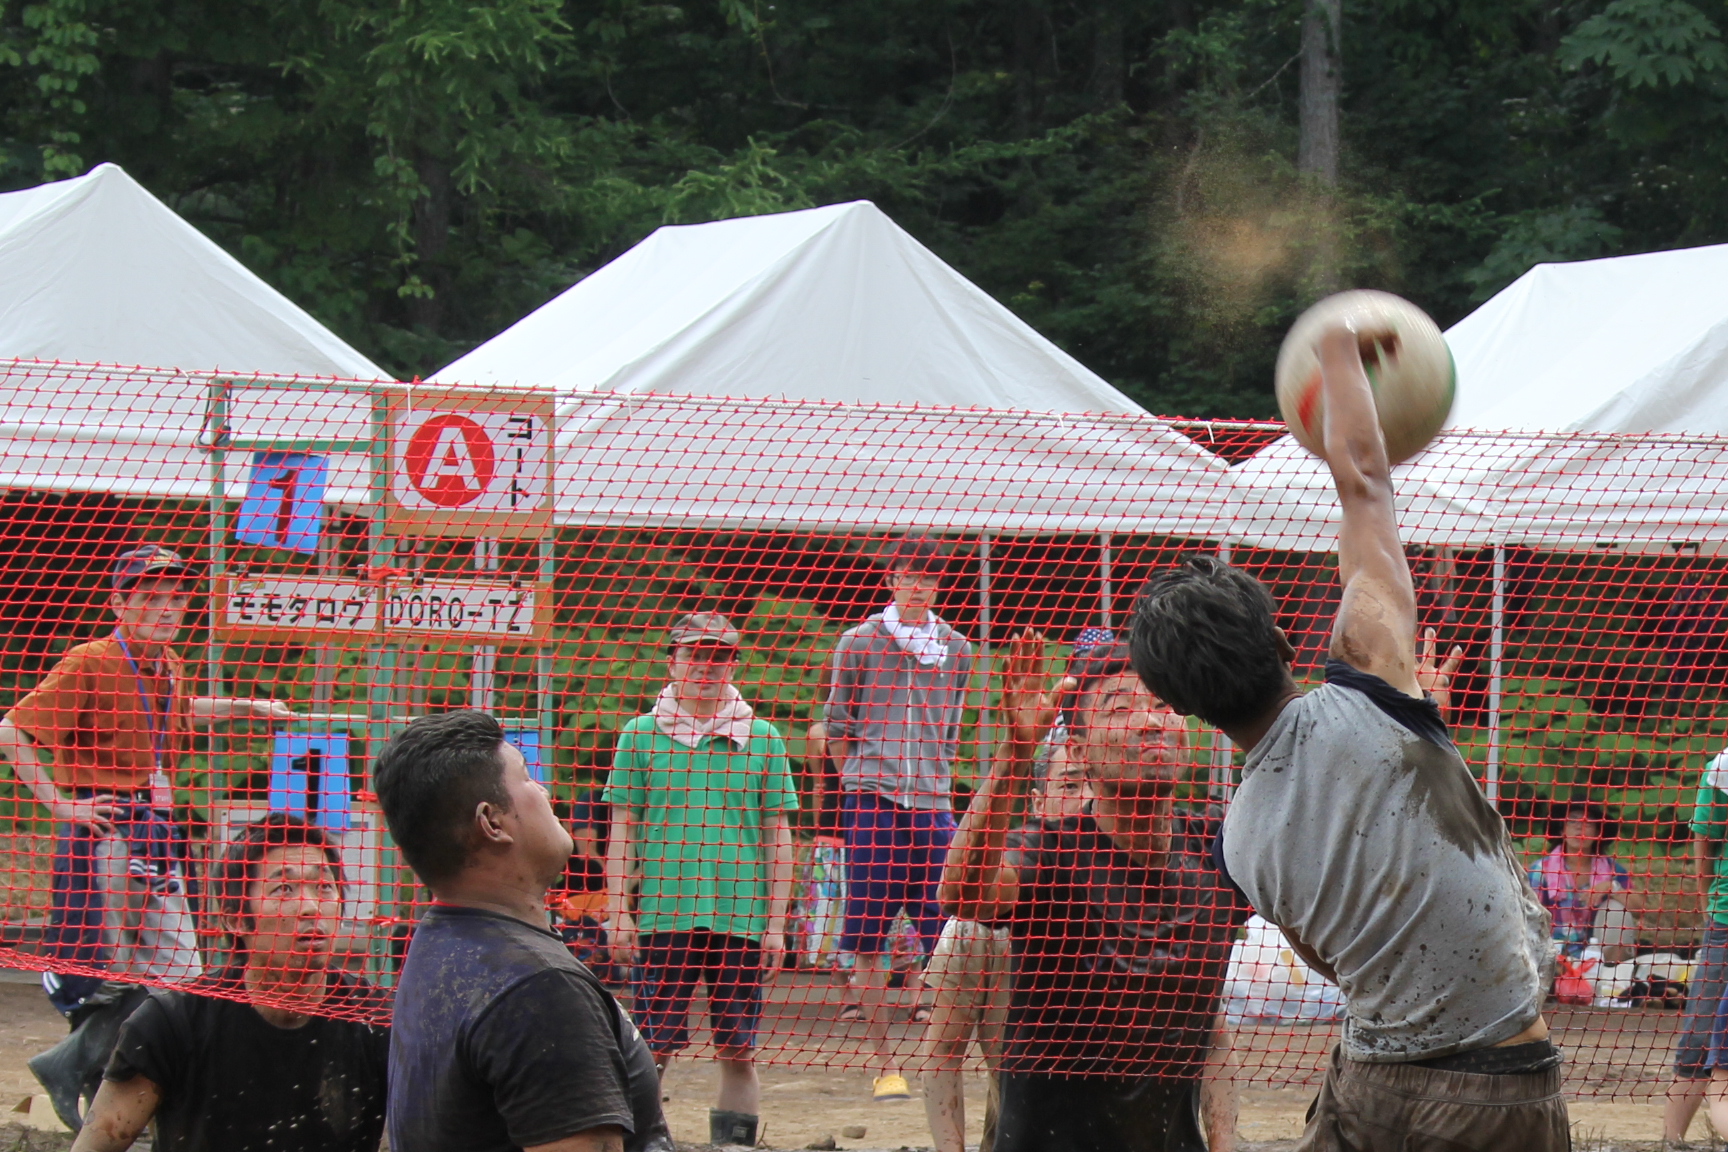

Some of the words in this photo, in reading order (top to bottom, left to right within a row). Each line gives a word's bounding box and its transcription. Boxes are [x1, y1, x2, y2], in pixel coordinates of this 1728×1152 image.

[418, 426, 485, 491] A
[507, 417, 533, 507] コート
[268, 469, 299, 545] 1
[232, 591, 365, 627] モモタロウ
[388, 594, 523, 632] DORO-TZ
[292, 748, 322, 823] 1
